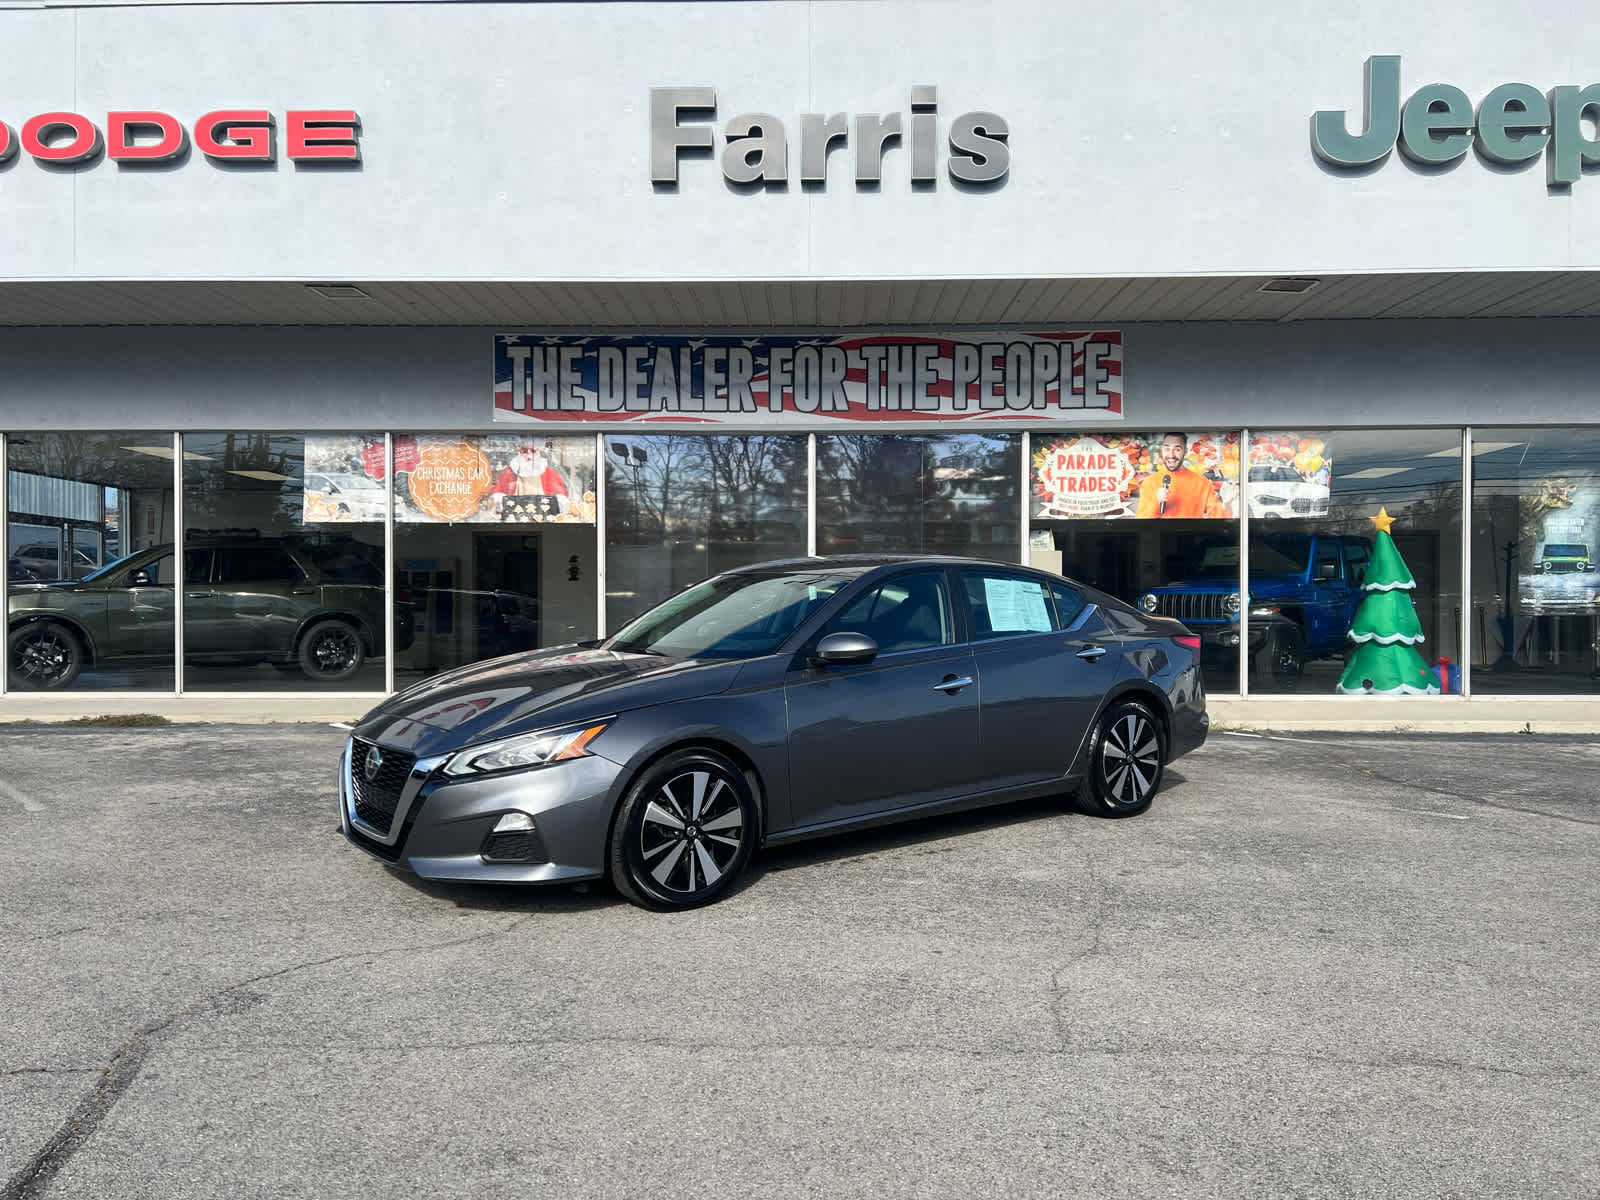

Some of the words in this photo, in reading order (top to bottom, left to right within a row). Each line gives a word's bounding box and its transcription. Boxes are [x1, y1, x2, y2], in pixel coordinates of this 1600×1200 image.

[0, 110, 361, 162] ODGE
[650, 85, 1010, 183] Farris
[1309, 55, 1600, 185] Jeep
[505, 344, 586, 411] THE
[597, 345, 757, 413] DEALER
[768, 344, 850, 413] FOR
[860, 343, 940, 411] THE
[953, 341, 1110, 410] PEOPLE
[417, 466, 465, 480] CHRISTMAS
[467, 466, 485, 480] CAR
[1057, 454, 1117, 470] PARADE
[429, 481, 473, 495] EXCHANGE
[1056, 476, 1117, 492] TRADES
